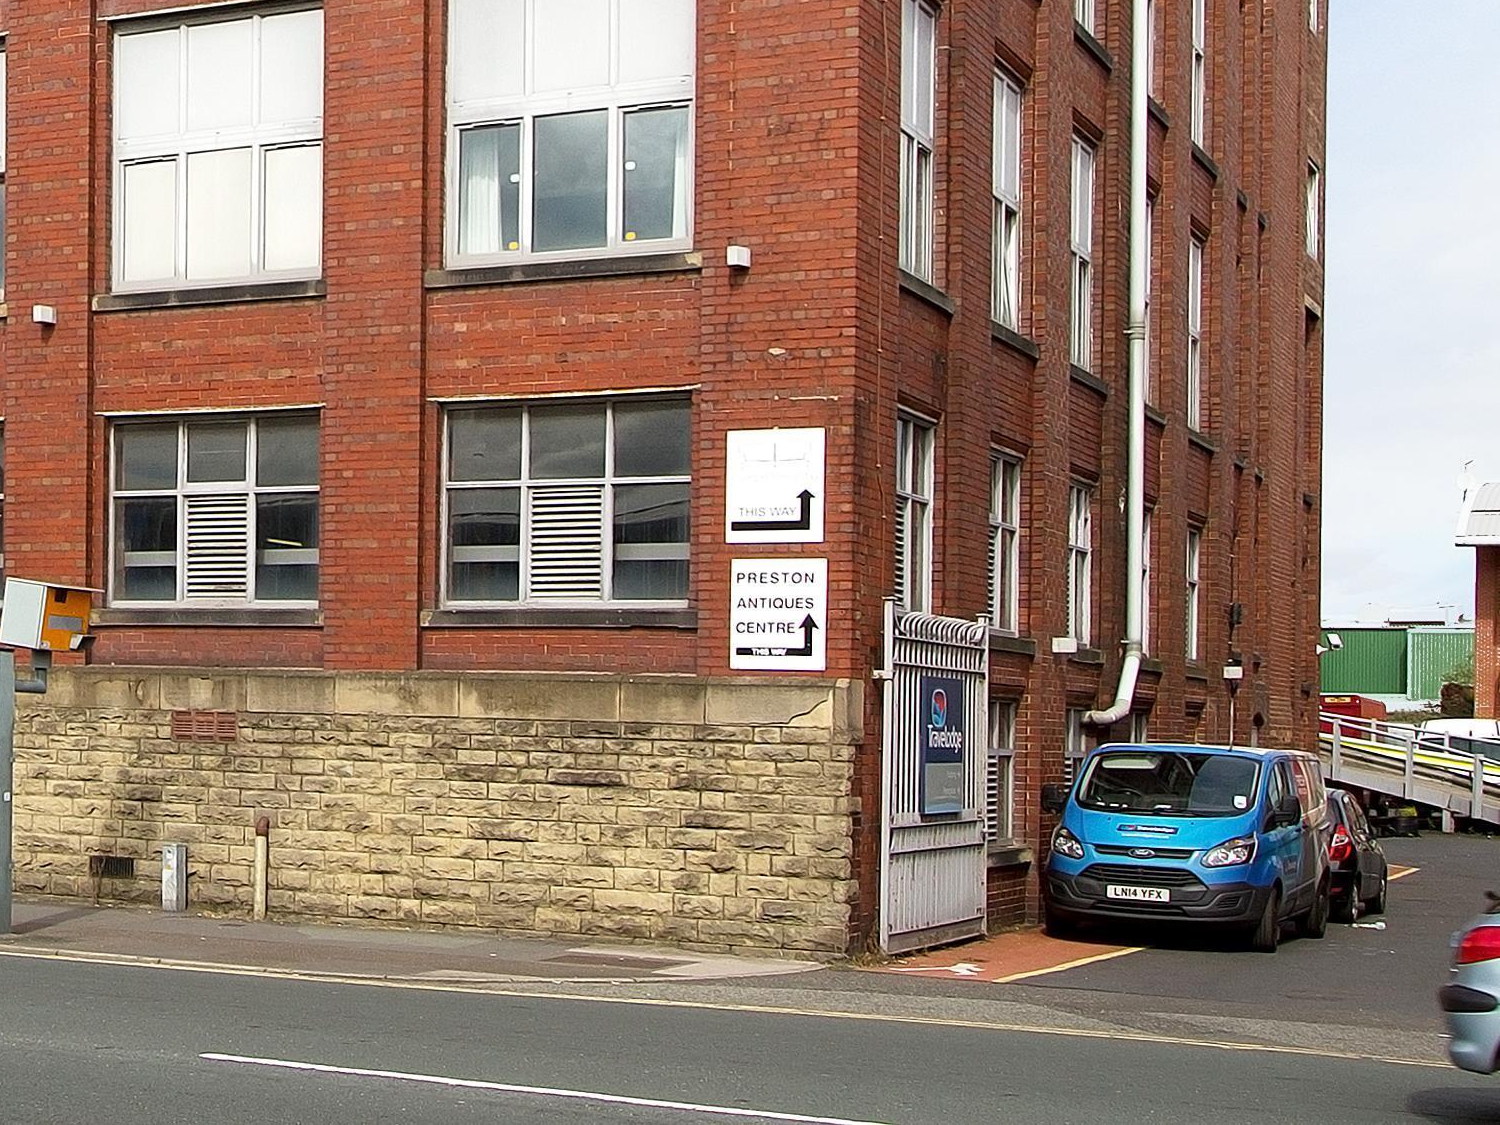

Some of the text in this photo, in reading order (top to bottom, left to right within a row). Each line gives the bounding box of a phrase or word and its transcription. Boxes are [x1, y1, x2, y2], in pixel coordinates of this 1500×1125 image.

[739, 506, 797, 517] THIS WAY
[737, 572, 815, 584] PRESTON
[737, 597, 814, 610] ANTIQUES
[736, 622, 796, 634] CENTRE
[927, 724, 962, 753] Travelodge
[1114, 887, 1163, 899] LN14 YFX
